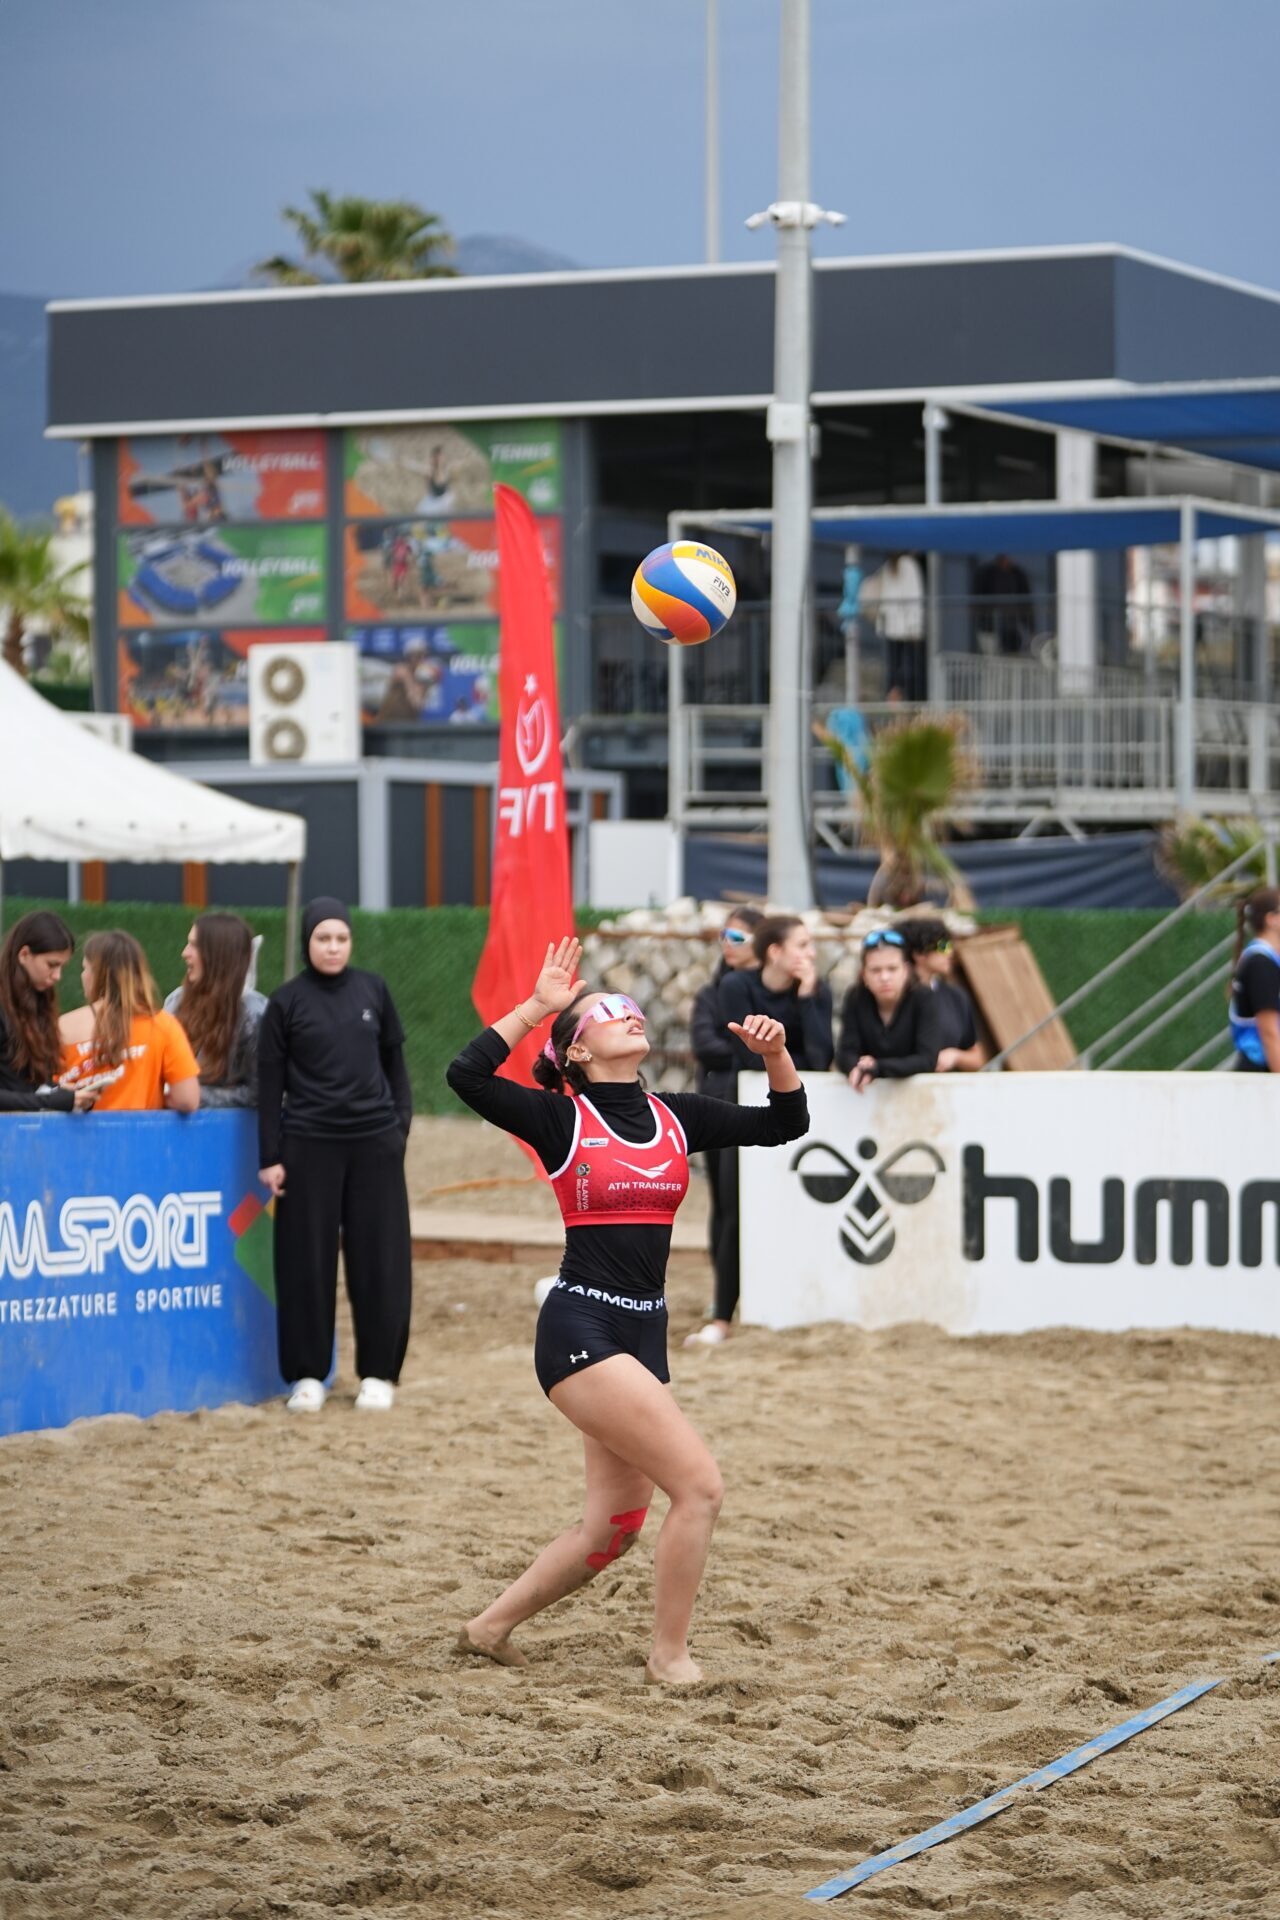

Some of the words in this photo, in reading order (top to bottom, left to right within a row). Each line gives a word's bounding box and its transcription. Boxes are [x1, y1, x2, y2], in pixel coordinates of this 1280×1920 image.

[221, 452, 320, 471] VOLLEYBALL
[221, 556, 320, 577] VOLLEYBALL
[581, 1178, 589, 1211] ALANYA
[607, 1182, 630, 1191] ATM
[632, 1181, 682, 1191] TRANSFER
[0, 1292, 117, 1323] TREZZATURE
[135, 1284, 222, 1313] SPORTIVE
[568, 1284, 653, 1311] ARMOUR
